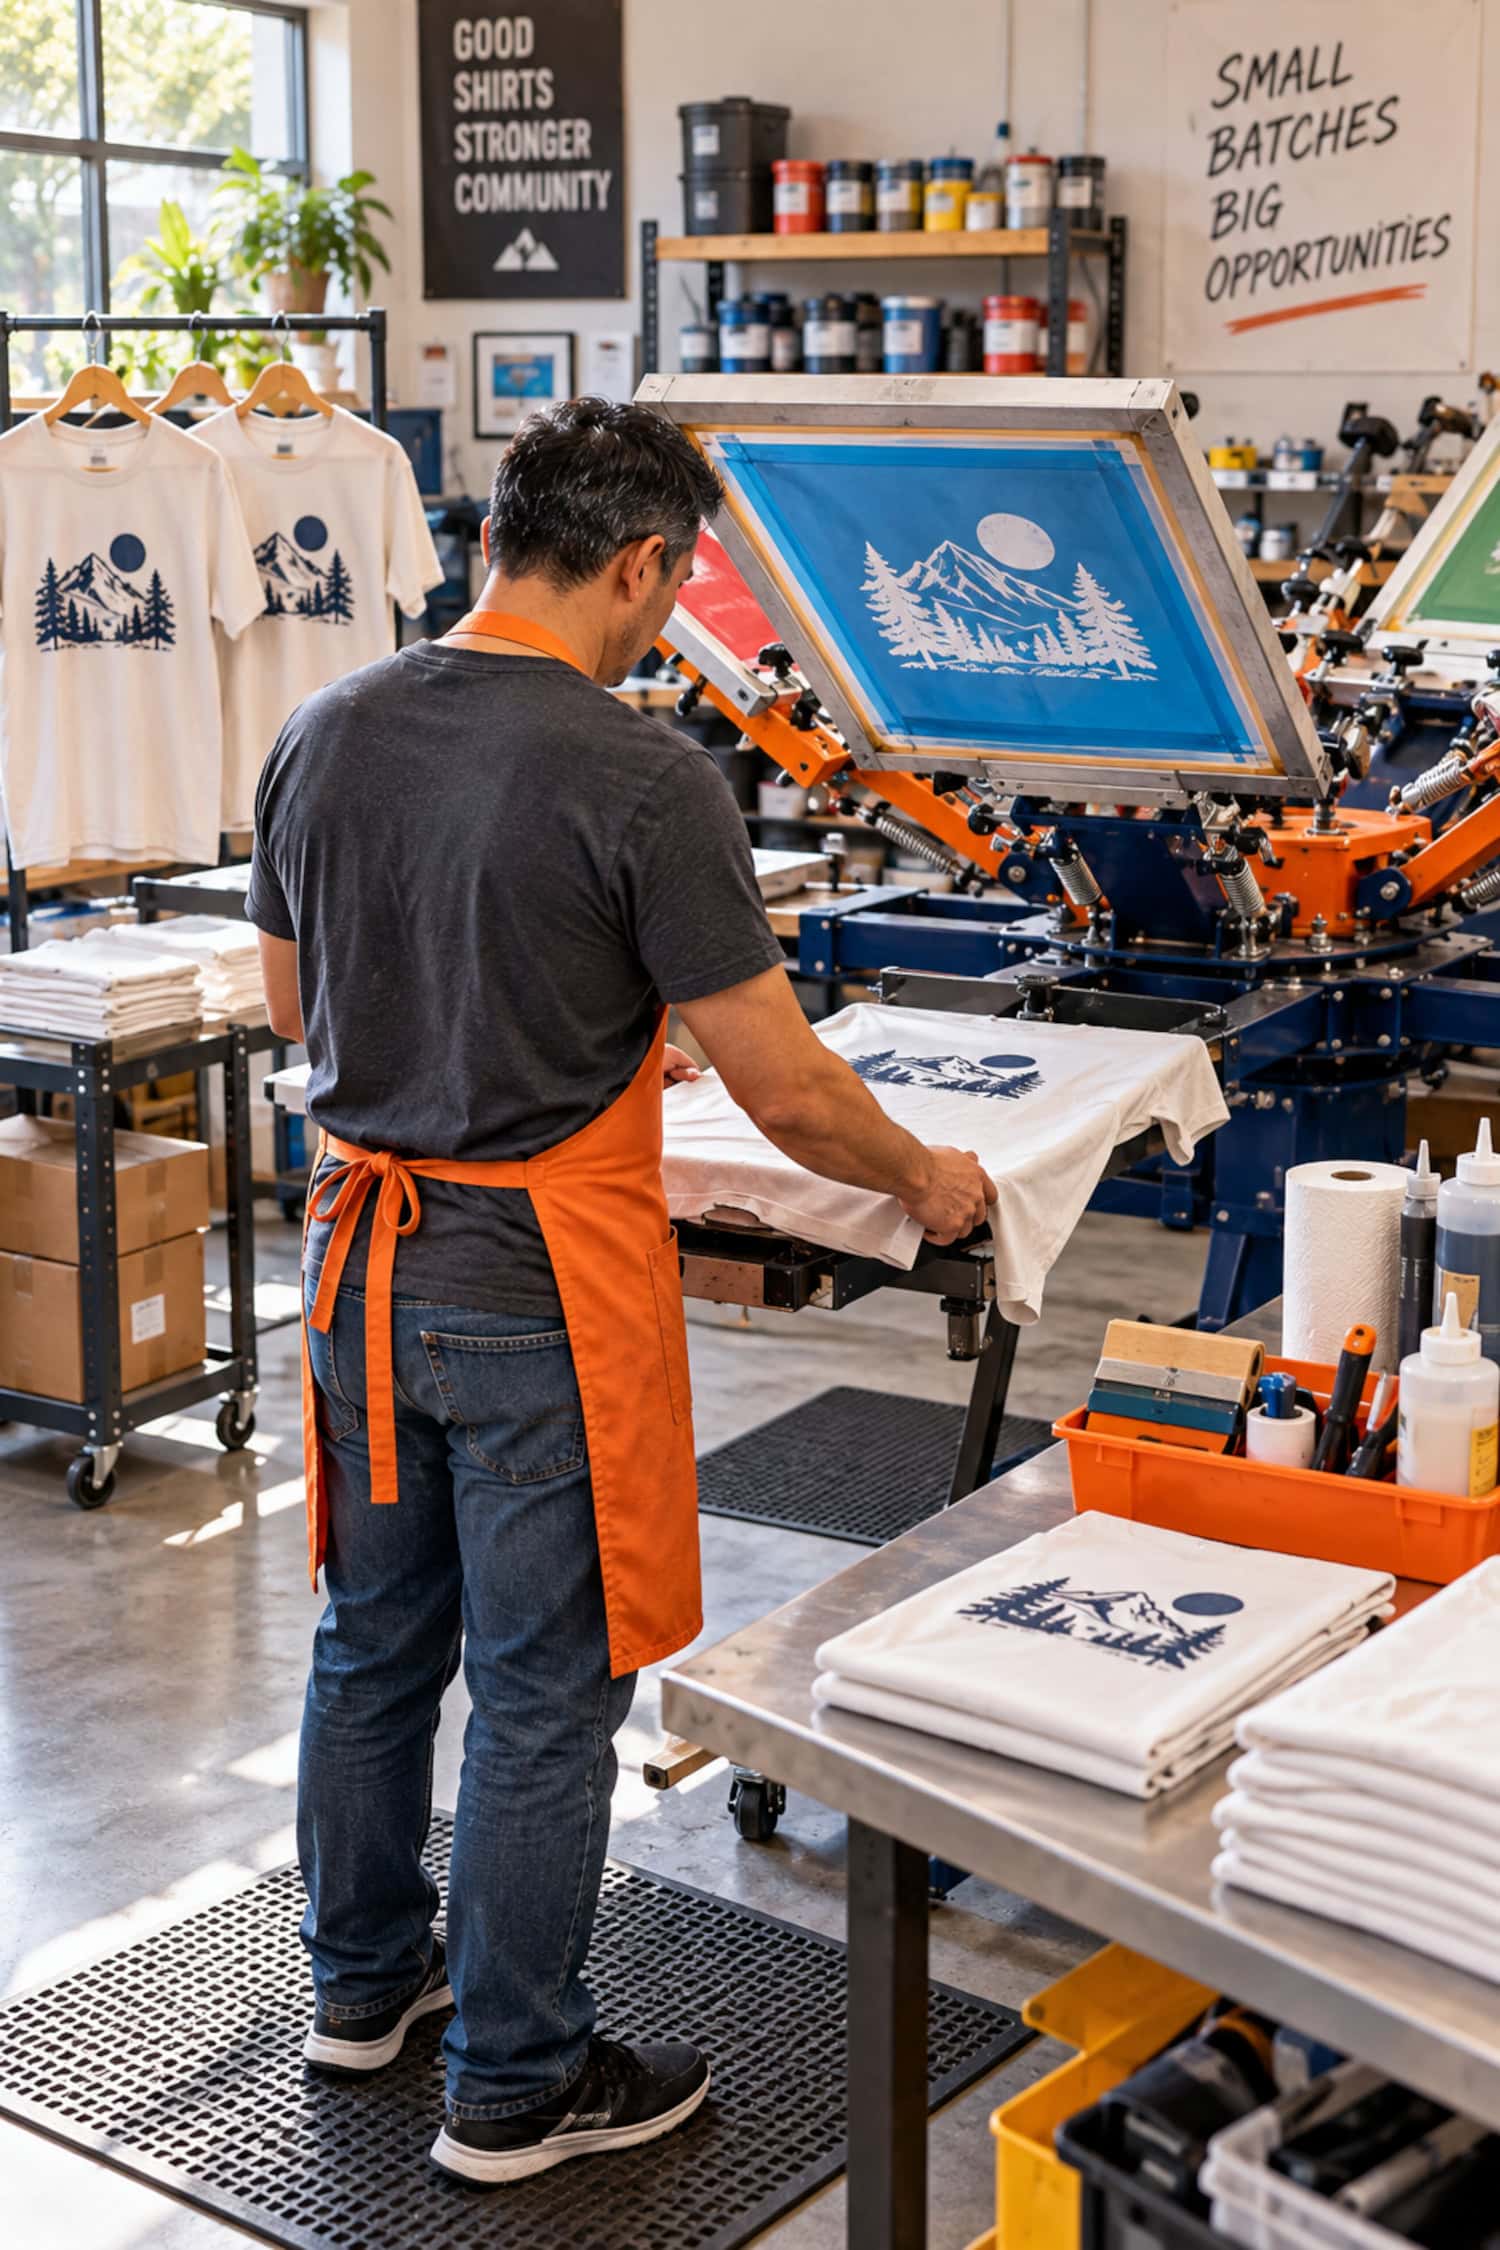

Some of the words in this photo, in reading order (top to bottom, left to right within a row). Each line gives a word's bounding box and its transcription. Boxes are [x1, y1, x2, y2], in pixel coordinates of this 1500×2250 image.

[453, 17, 534, 61] GOOD
[453, 68, 554, 112] SHIRTS
[1210, 42, 1353, 110] SMALL
[453, 119, 592, 163] STRONGER
[1206, 94, 1401, 178] BATCHES
[454, 170, 612, 214] COMMUNITY
[1209, 181, 1285, 241] BIG
